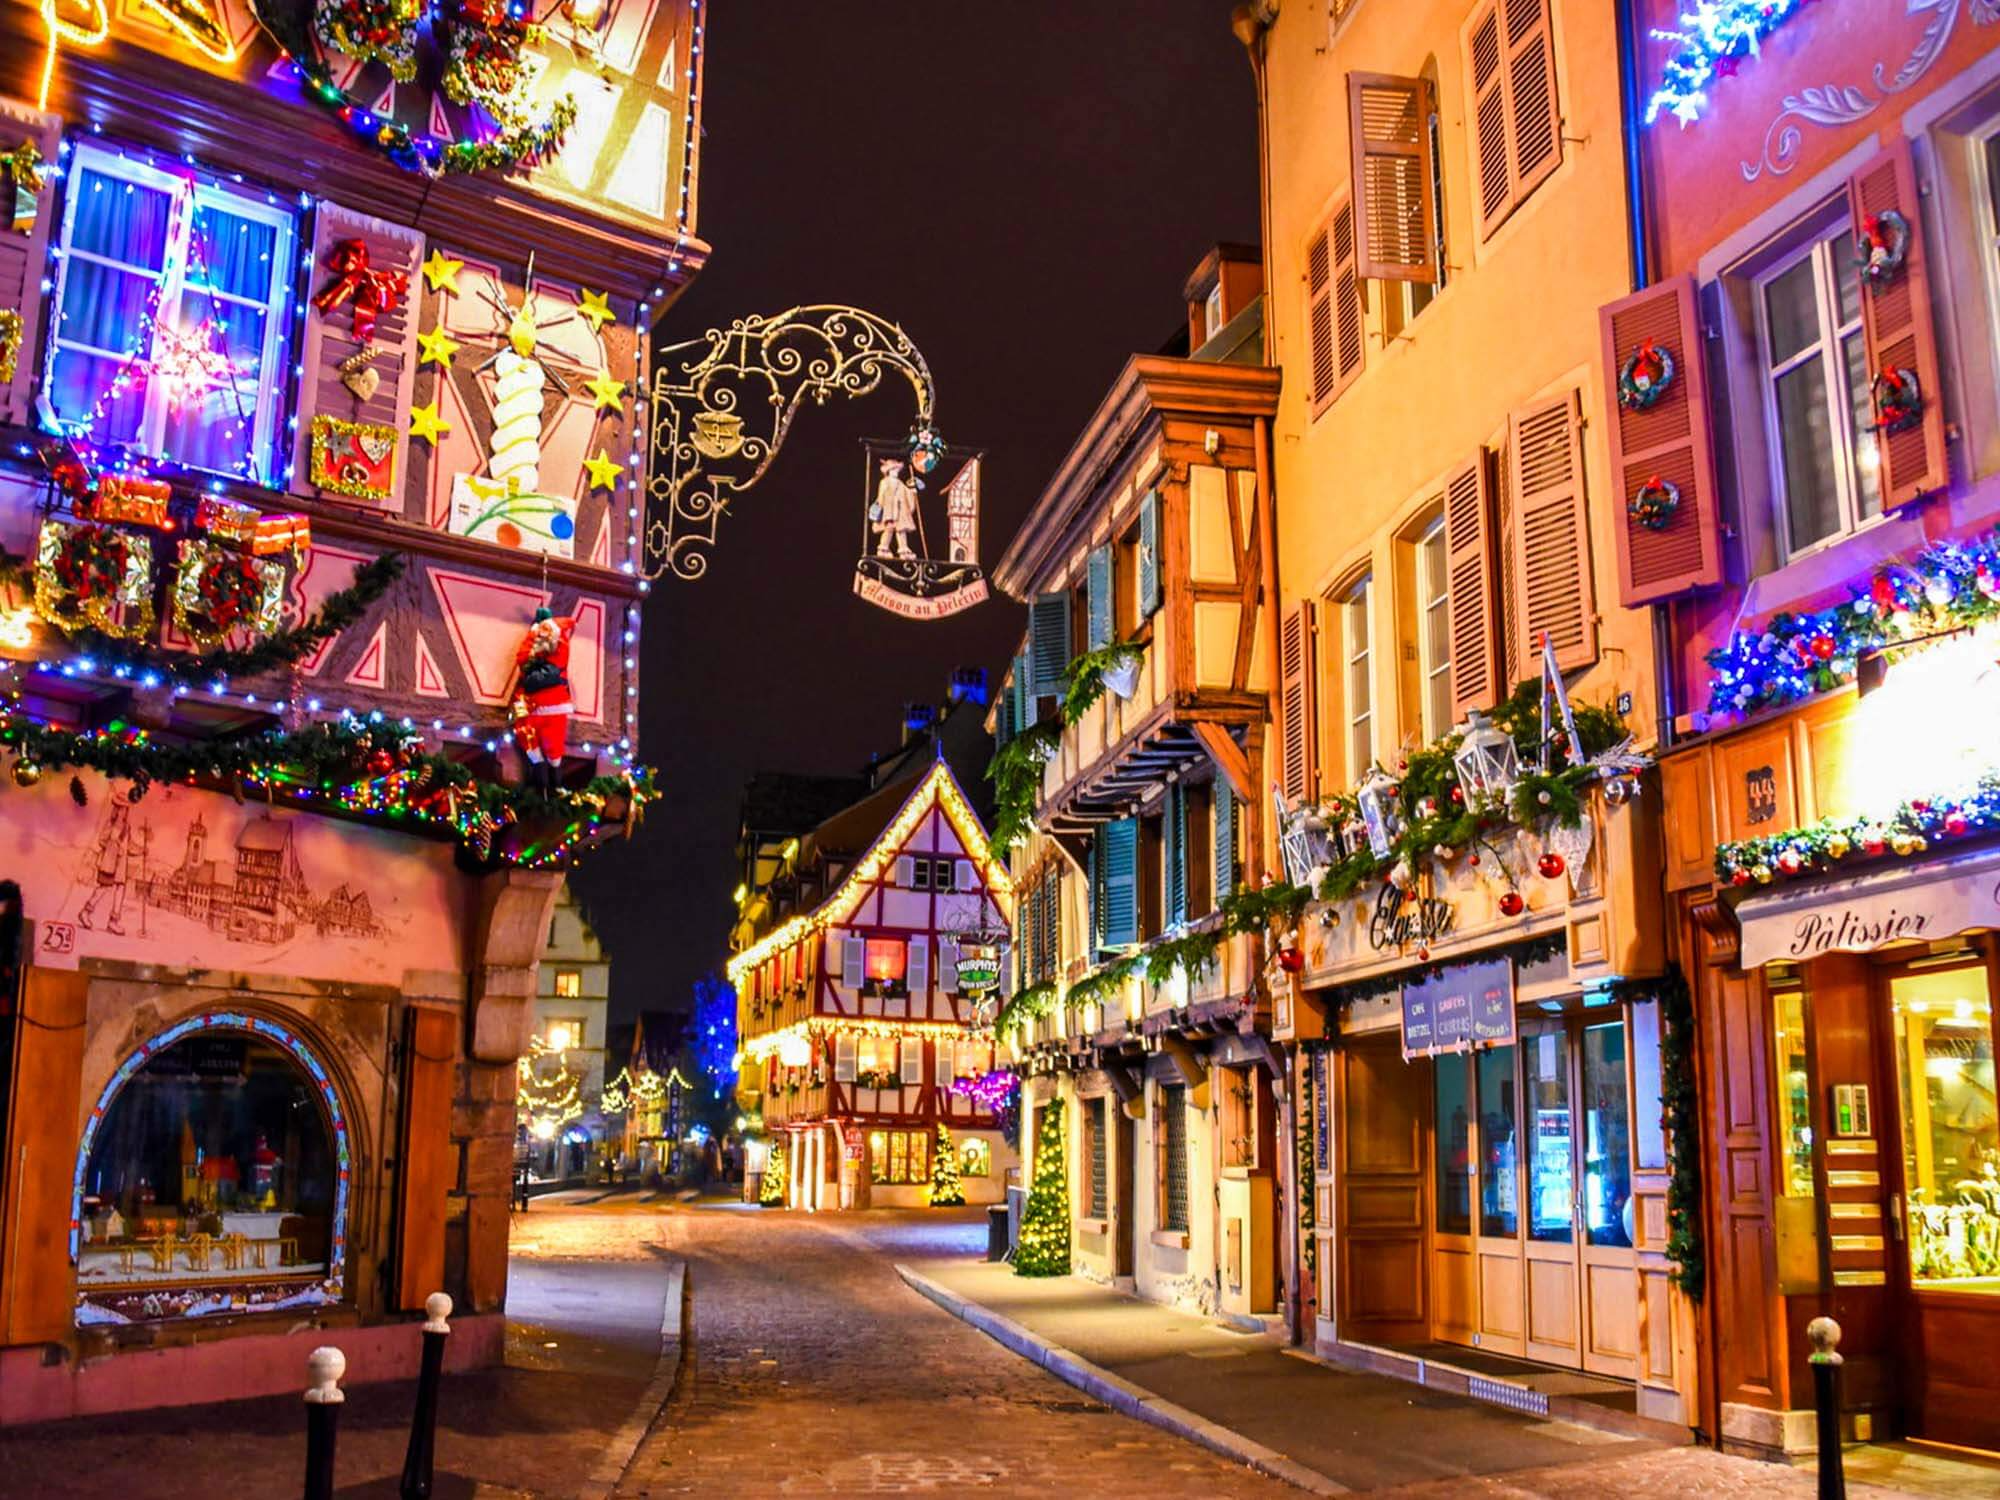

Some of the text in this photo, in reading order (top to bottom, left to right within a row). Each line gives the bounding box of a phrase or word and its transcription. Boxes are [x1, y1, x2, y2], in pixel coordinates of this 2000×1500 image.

[863, 583, 912, 612] Maison
[914, 604, 931, 615] au
[1790, 909, 1934, 955] Pâtissier
